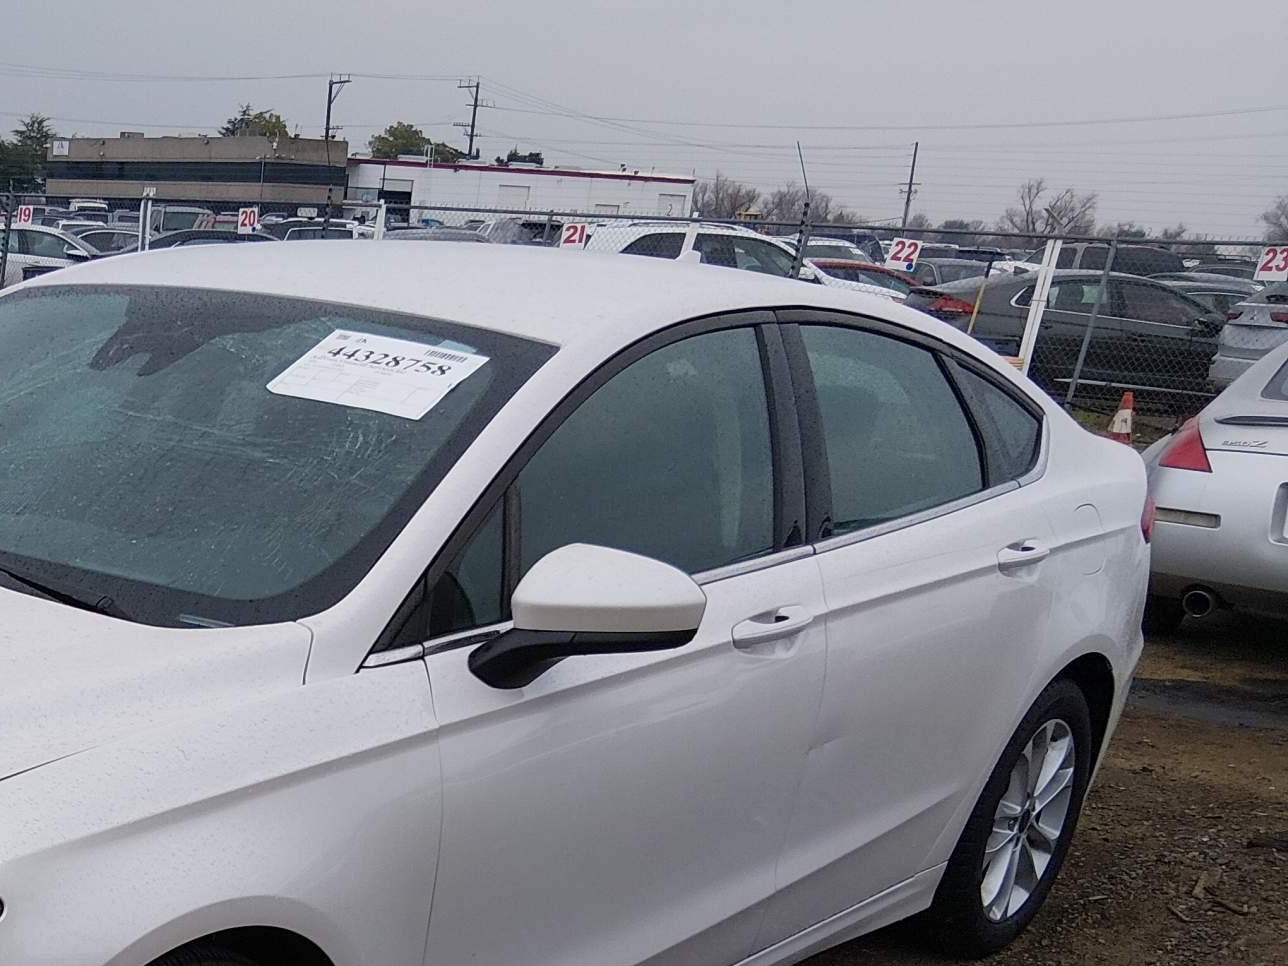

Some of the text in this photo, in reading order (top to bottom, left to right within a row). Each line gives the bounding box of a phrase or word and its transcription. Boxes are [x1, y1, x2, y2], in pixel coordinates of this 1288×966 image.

[18, 207, 32, 223] 19
[240, 210, 256, 227] 20
[563, 224, 586, 244] 21
[890, 240, 919, 263] 22
[1259, 247, 1288, 272] 23
[328, 344, 452, 377] 44328758
